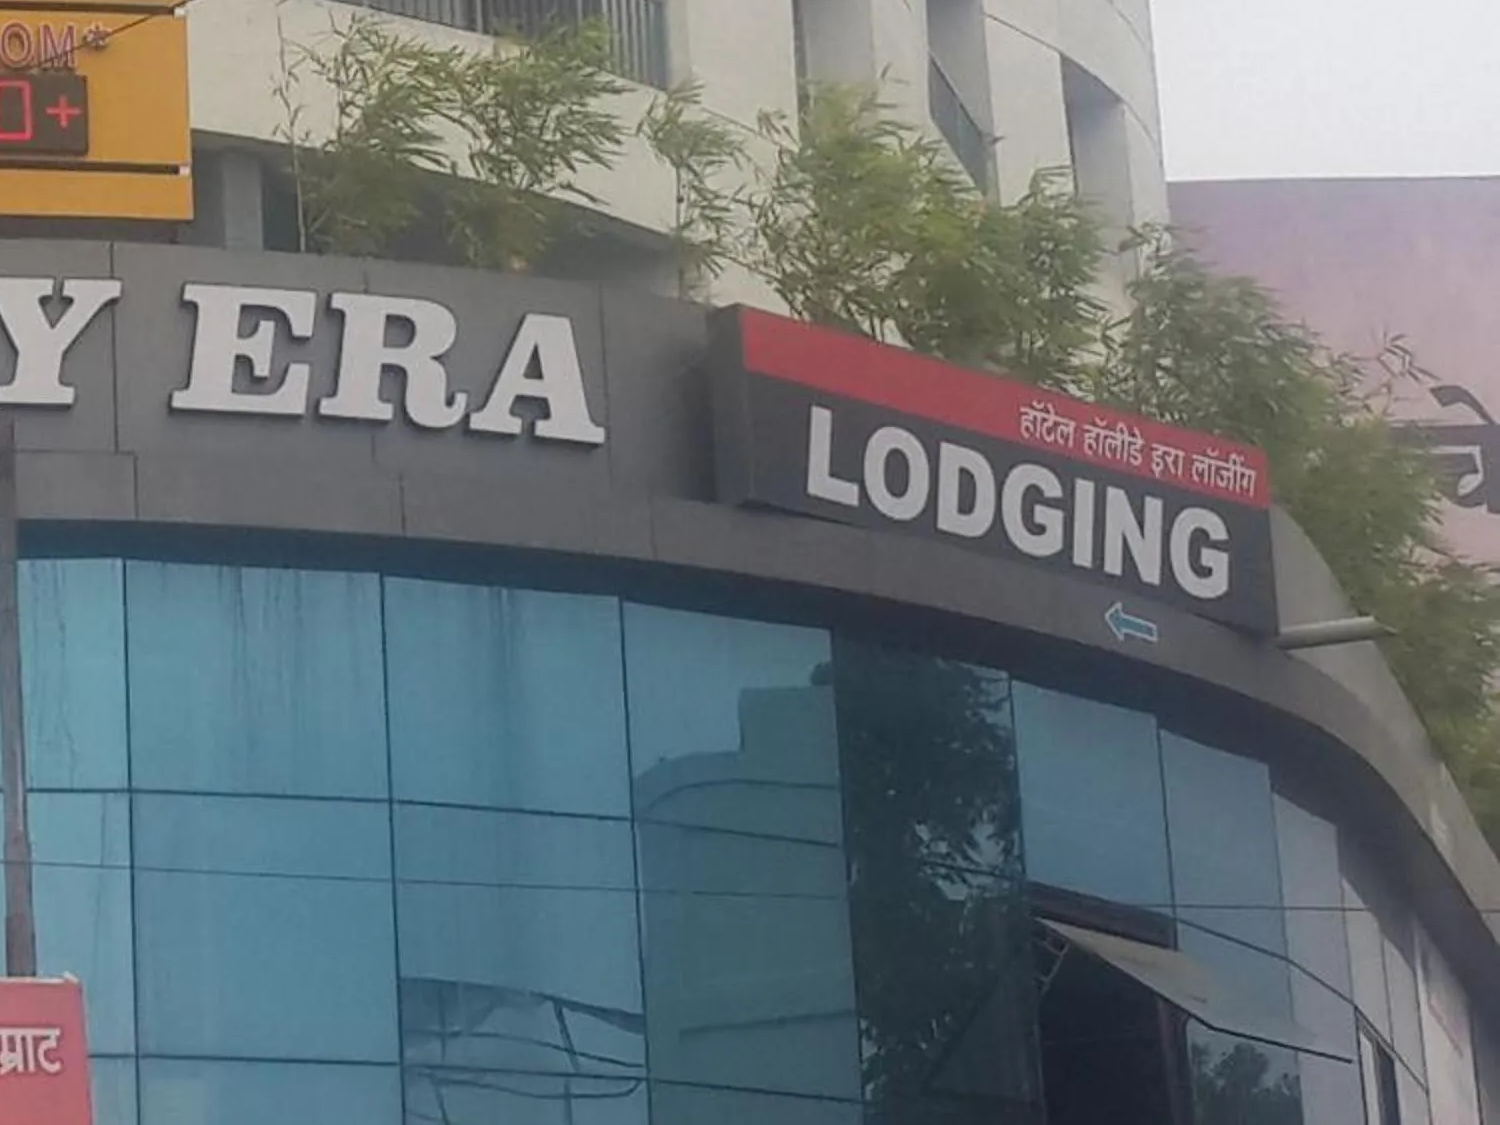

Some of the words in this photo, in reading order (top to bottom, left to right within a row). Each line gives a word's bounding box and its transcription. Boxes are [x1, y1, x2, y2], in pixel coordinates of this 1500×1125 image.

[170, 283, 606, 445] ERA
[1020, 400, 1076, 448] हॉटेल
[1151, 442, 1185, 478] इरा
[805, 404, 1231, 598] LODGING
